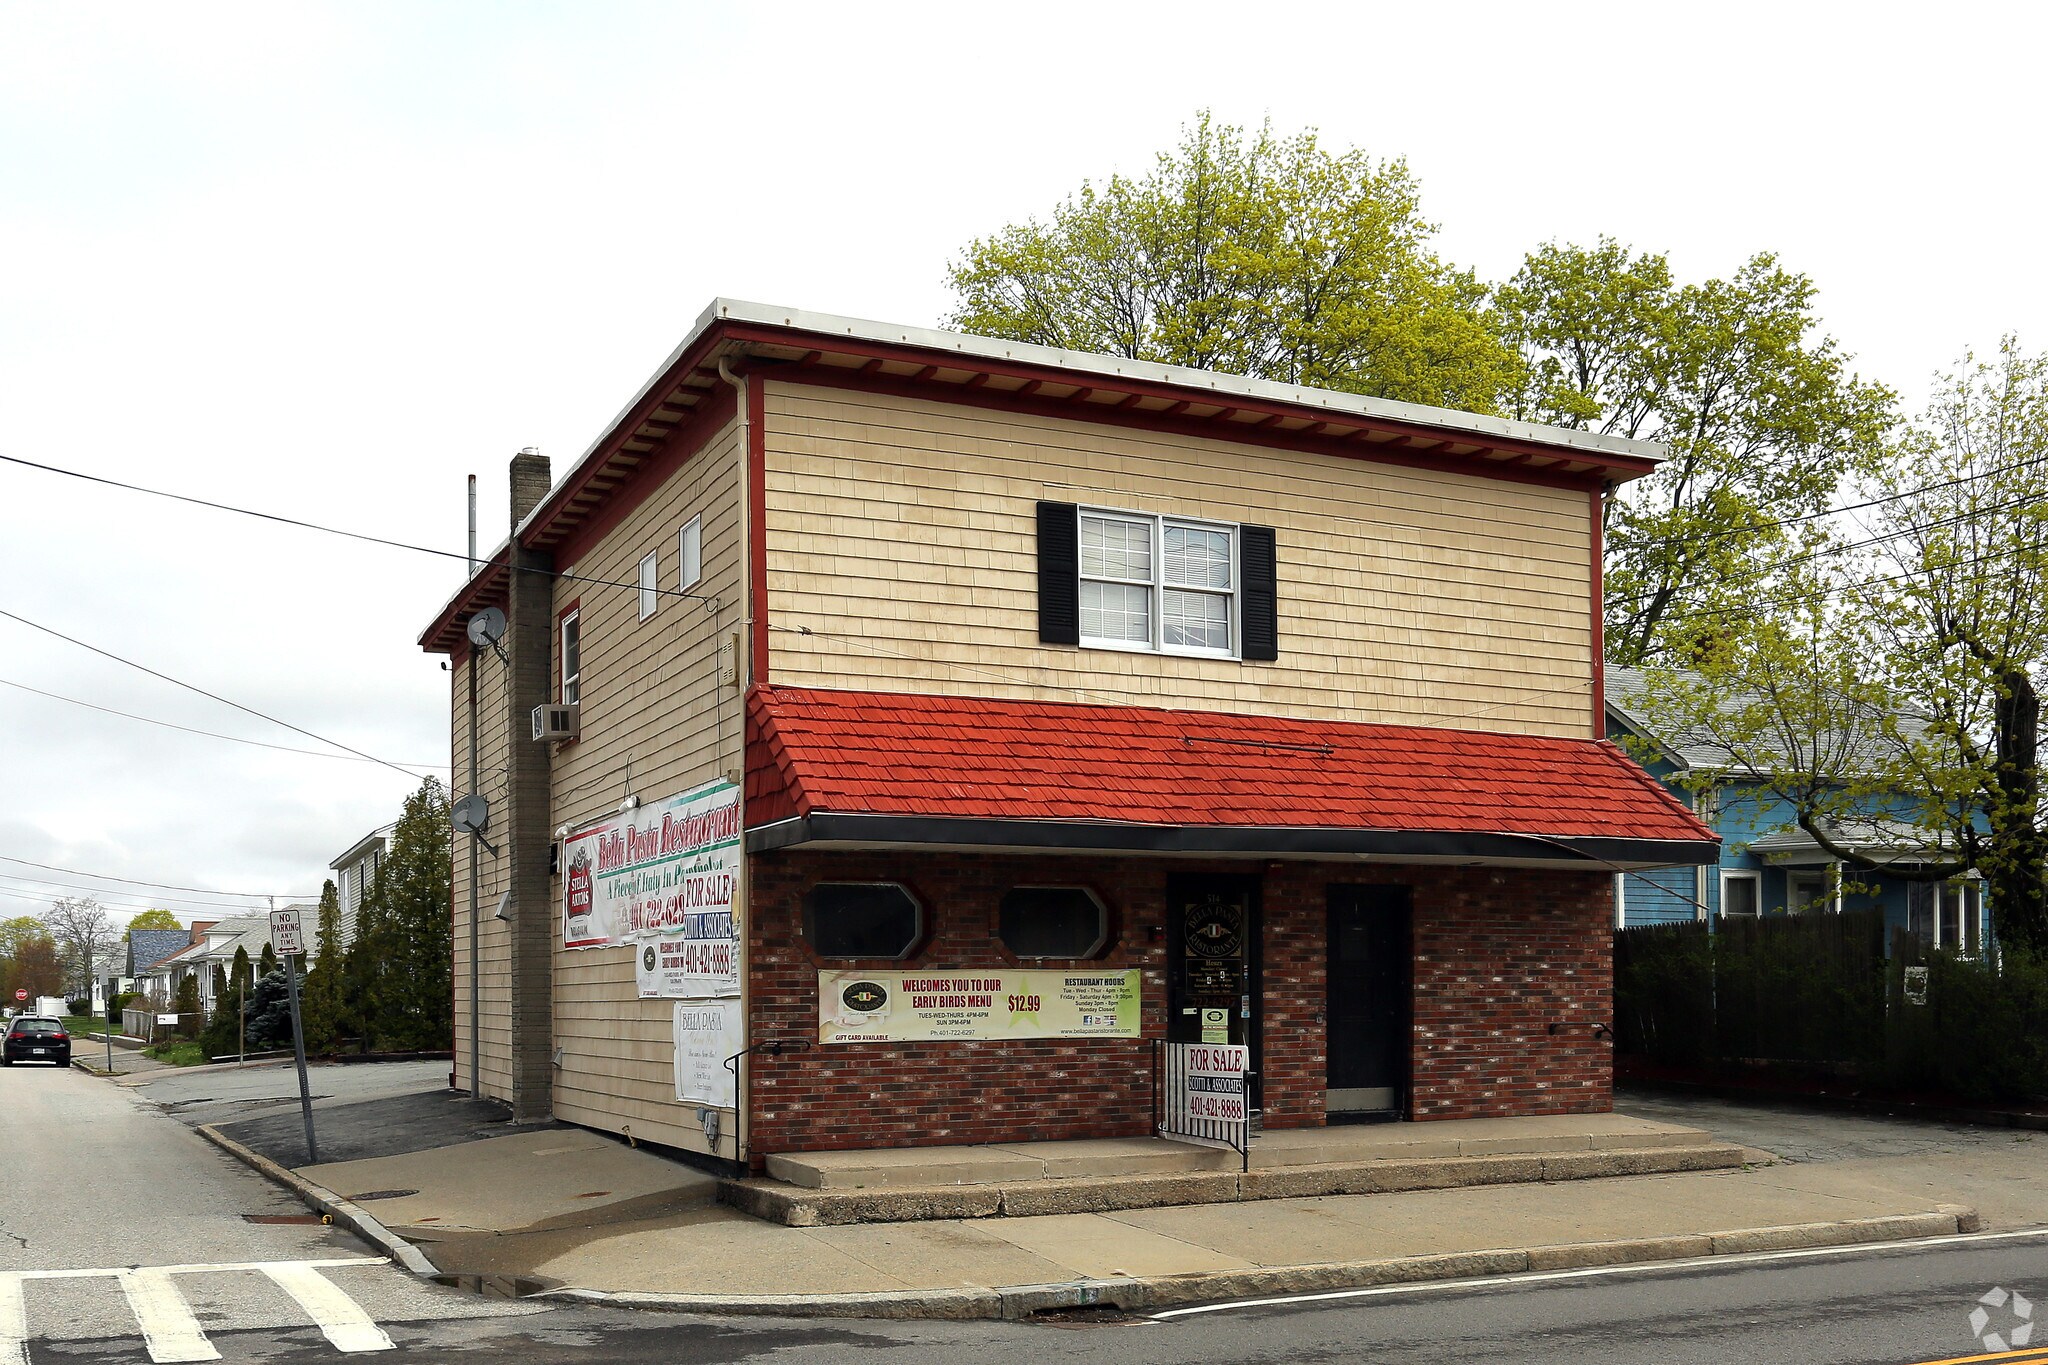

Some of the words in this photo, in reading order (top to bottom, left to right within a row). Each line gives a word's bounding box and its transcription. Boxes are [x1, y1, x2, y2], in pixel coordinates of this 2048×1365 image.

[598, 829, 624, 873] Bella
[626, 821, 659, 866] Pasta
[660, 793, 740, 856] Restaurant
[572, 875, 588, 891] STELLA
[614, 878, 631, 898] Piece
[642, 870, 660, 895] Italy
[662, 867, 671, 888] In
[686, 877, 704, 907] FOR
[705, 875, 730, 906] SALE
[279, 914, 291, 922] NO
[631, 902, 643, 931] 401
[646, 893, 685, 929] 722-629
[272, 923, 299, 933] PARKING
[281, 932, 293, 940] ANY
[1188, 933, 1239, 955] RISTORANTE
[902, 979, 950, 992] WELCOMES
[952, 979, 969, 992] YOU
[970, 979, 981, 992] TO
[983, 979, 1001, 991] OUR
[1065, 978, 1103, 986] RESTAURANT
[912, 995, 938, 1008] EARLY
[940, 995, 966, 1008] BIRDS
[968, 995, 992, 1007] MENU
[1008, 994, 1040, 1013] $12.99
[1190, 1049, 1209, 1070] FOR
[1213, 1049, 1242, 1072] SALE
[1190, 1077, 1206, 1090] SCOTTI
[1206, 1078, 1211, 1091] &
[1212, 1078, 1242, 1093] ASSOCIATES
